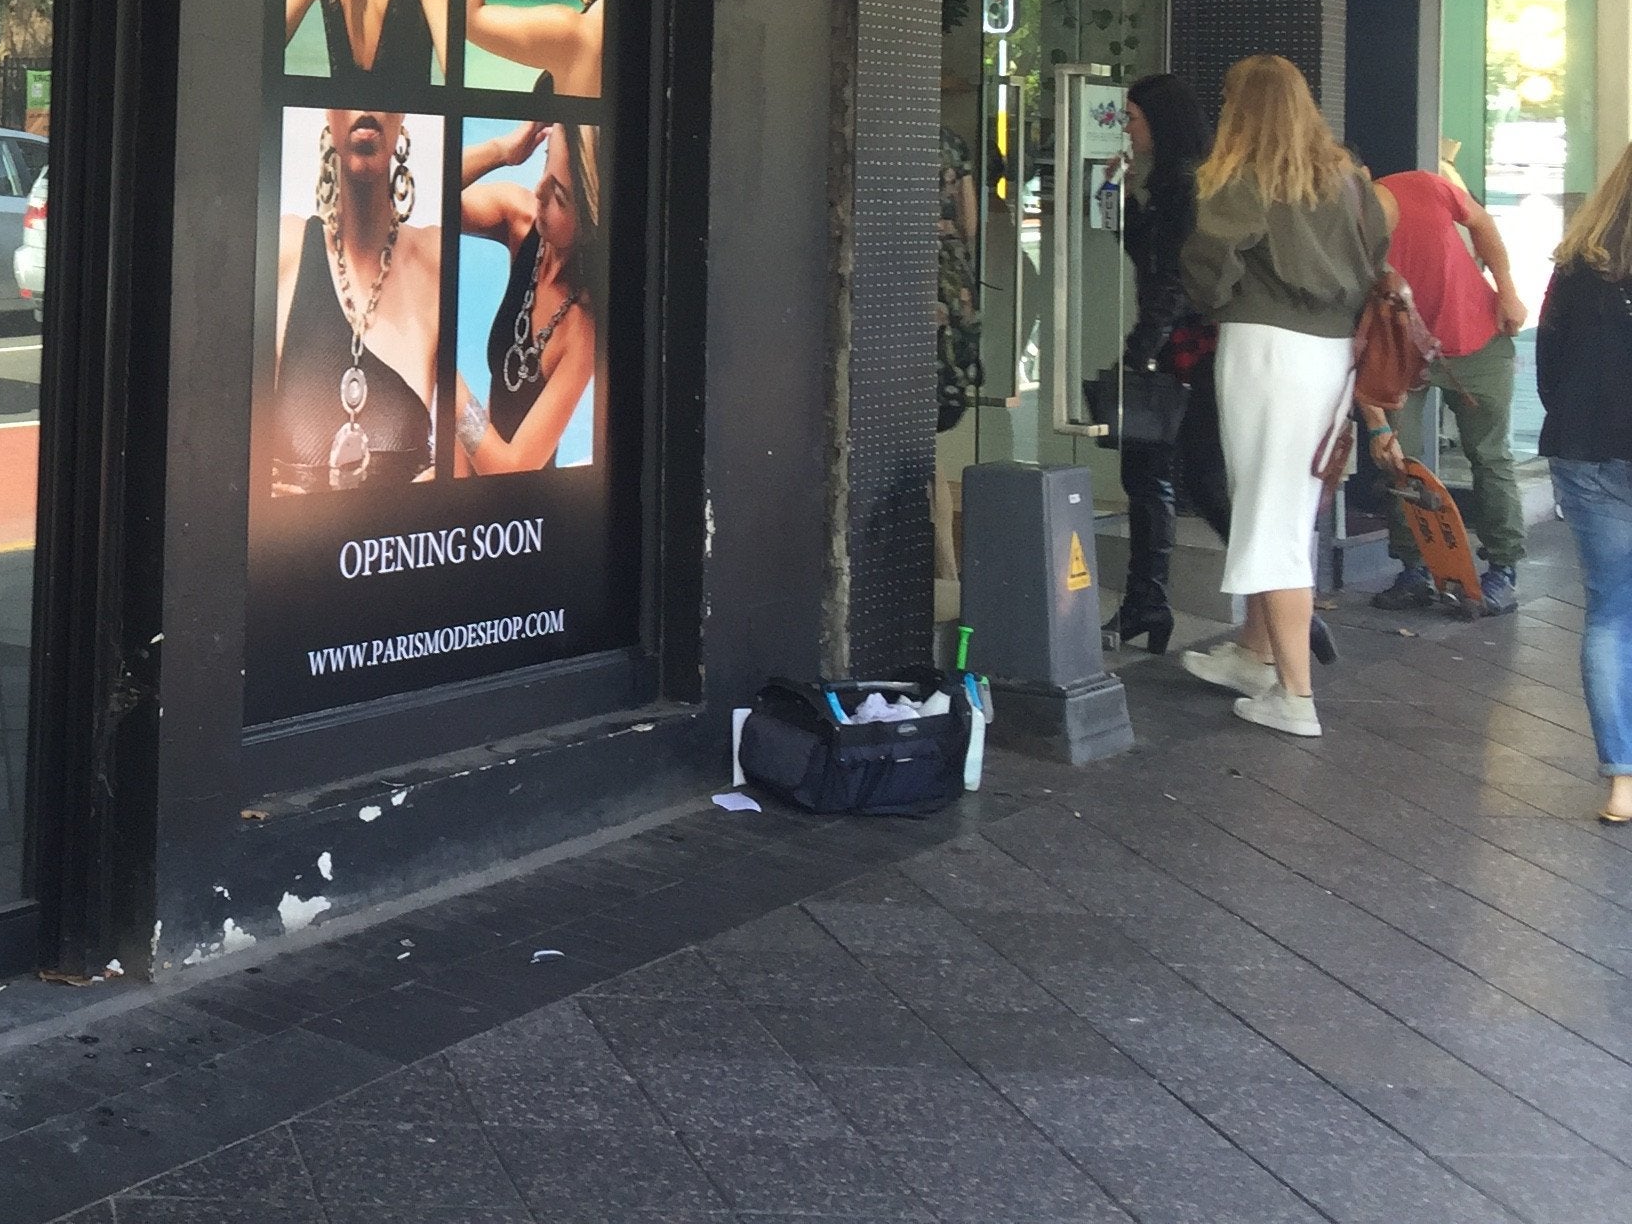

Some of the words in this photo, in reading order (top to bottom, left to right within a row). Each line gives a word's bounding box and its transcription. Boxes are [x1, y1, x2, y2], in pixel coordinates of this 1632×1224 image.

[339, 528, 467, 579] OPENING
[472, 518, 544, 561] SOON
[307, 608, 565, 676] WWW.PARISMODESHOP.COM
